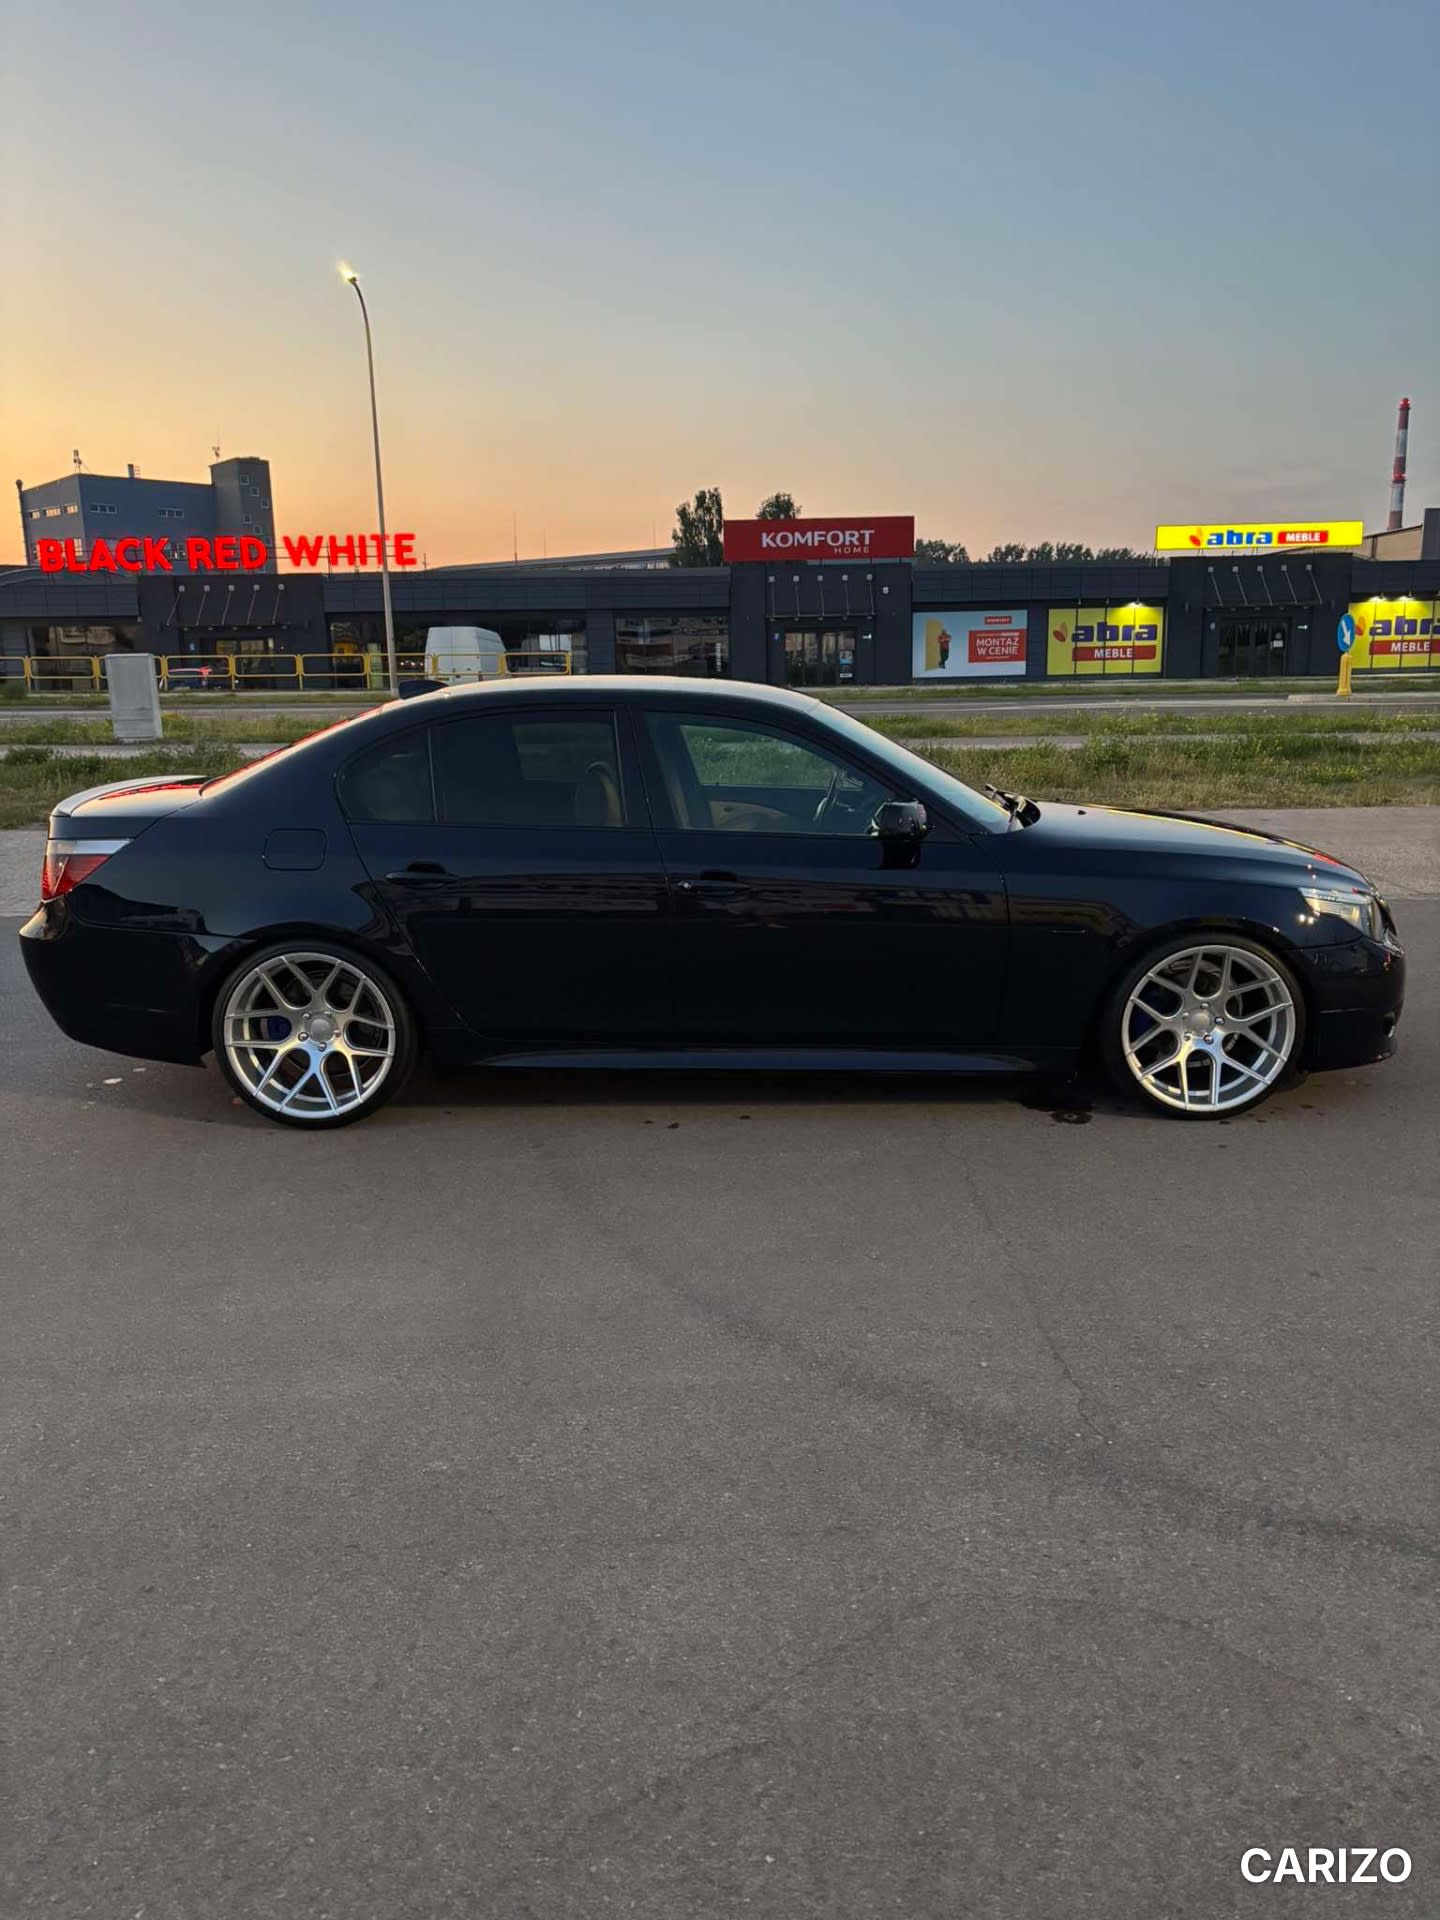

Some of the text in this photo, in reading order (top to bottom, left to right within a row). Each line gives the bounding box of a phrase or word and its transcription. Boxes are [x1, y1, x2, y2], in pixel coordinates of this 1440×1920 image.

[761, 530, 875, 548] KOMFORT
[1207, 529, 1321, 546] abra MEBLE
[37, 533, 417, 573] BLACK RED WHITE
[834, 546, 869, 554] HOME
[1072, 621, 1158, 642] abra
[977, 646, 1019, 656] W CENIE
[1094, 648, 1133, 658] MEBLE
[1390, 641, 1431, 653] MEBLE
